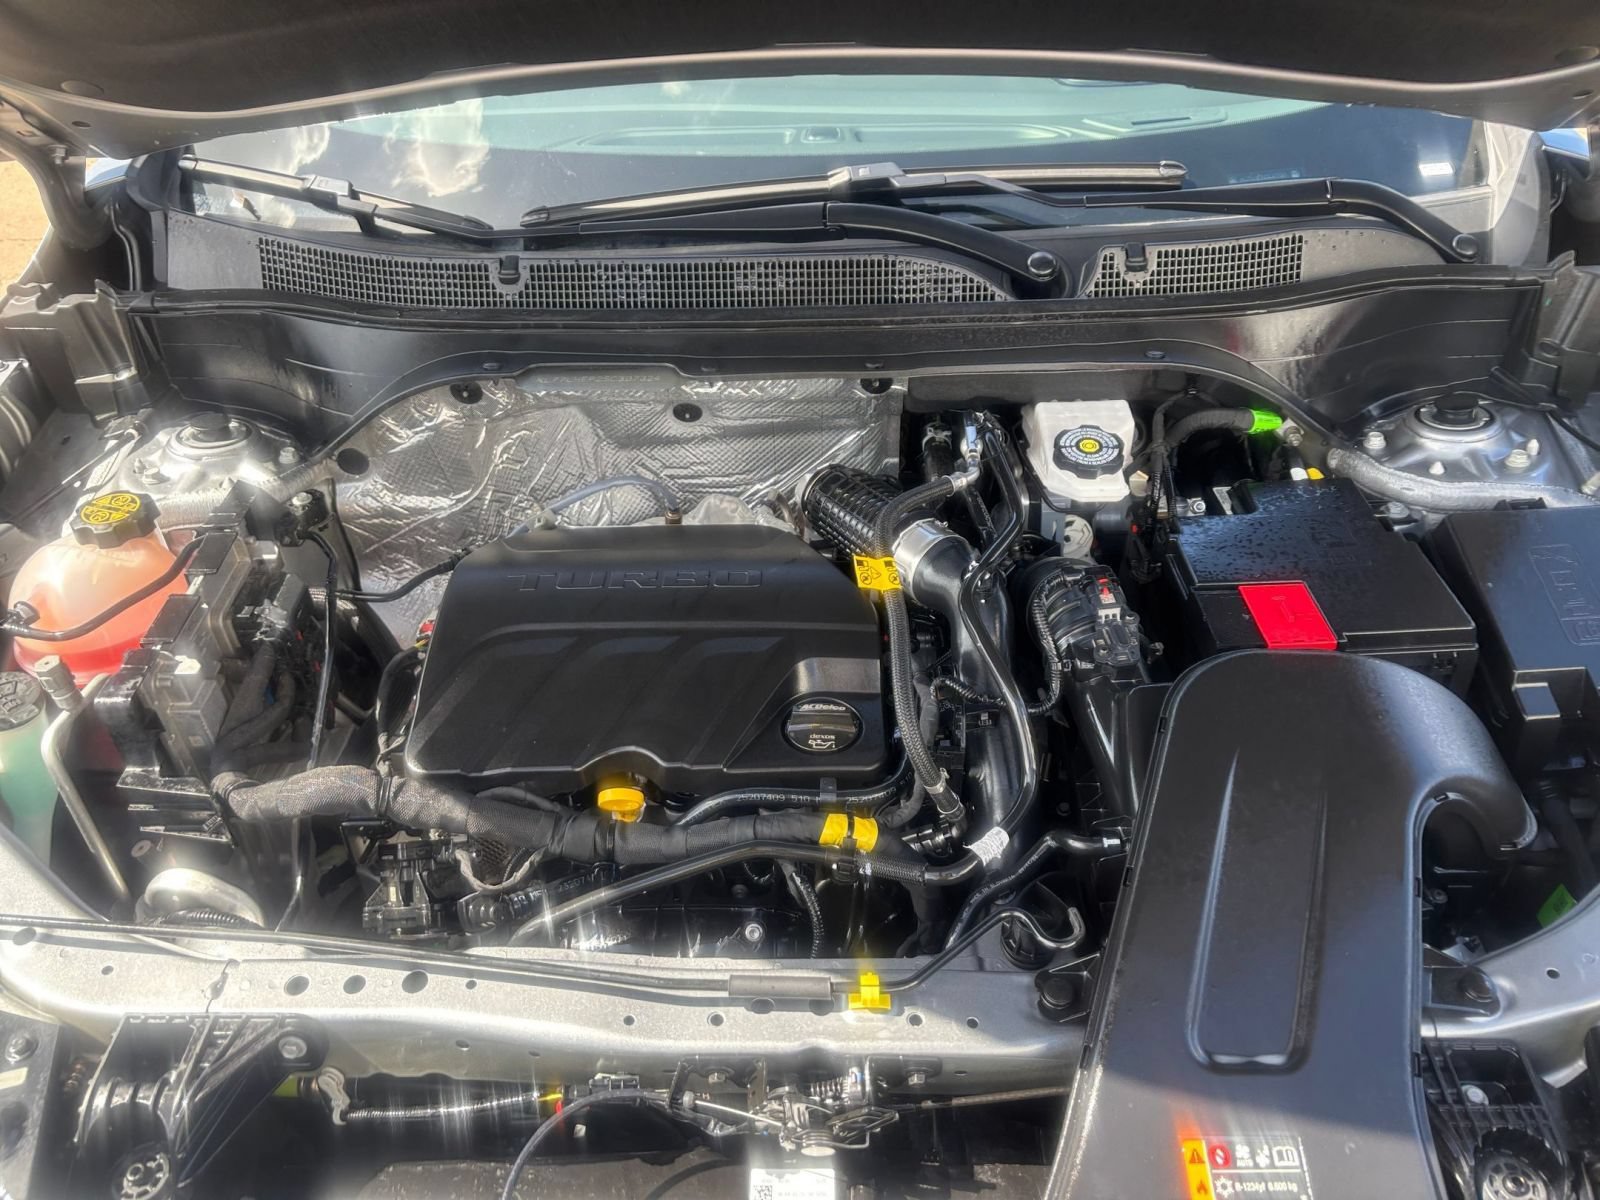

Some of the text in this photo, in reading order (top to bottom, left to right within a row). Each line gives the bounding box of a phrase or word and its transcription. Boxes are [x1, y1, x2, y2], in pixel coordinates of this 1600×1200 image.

[507, 570, 763, 591] TURBO
[800, 703, 847, 712] ACDelco
[791, 795, 810, 803] 510
